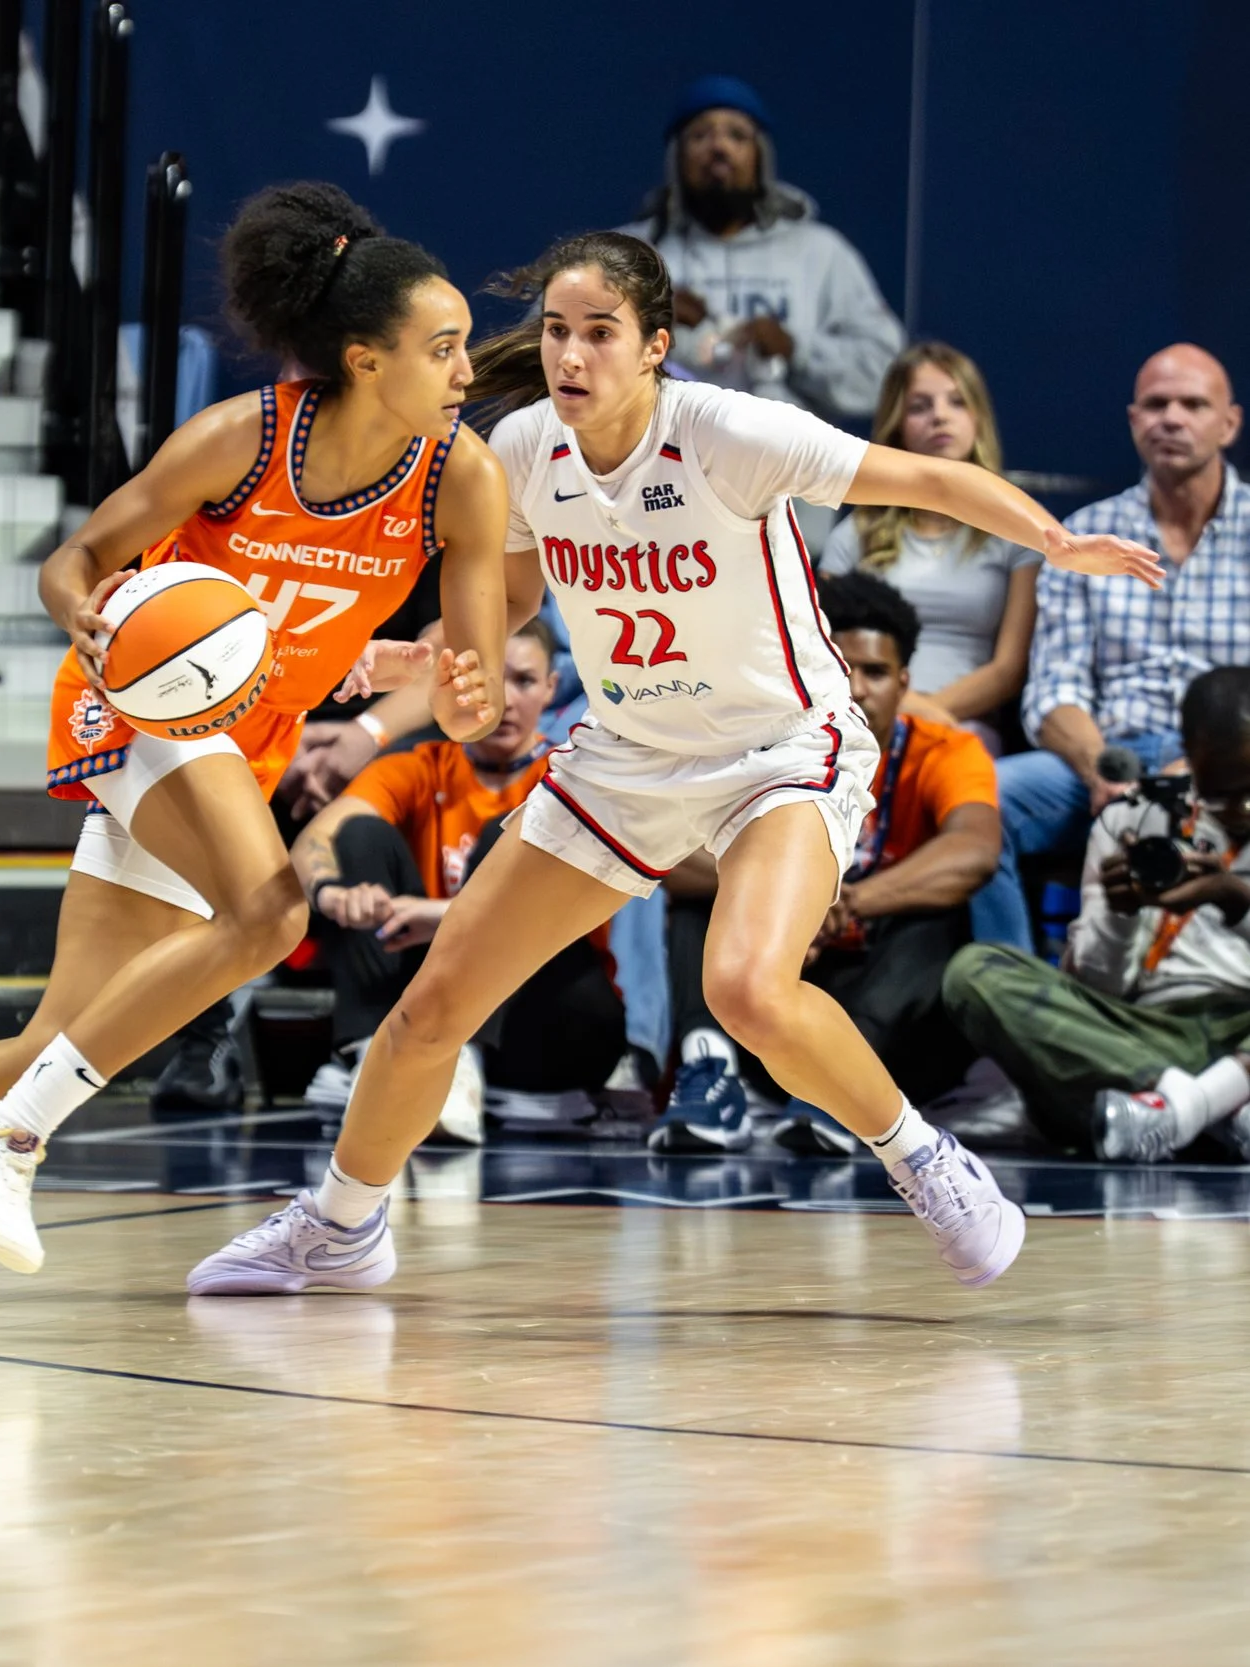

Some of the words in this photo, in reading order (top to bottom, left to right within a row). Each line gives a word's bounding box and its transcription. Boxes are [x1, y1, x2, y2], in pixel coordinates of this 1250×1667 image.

[641, 483, 675, 499] CAR
[643, 494, 686, 512] max
[228, 532, 406, 577] CONNECTICUT
[245, 573, 360, 634] 47
[595, 607, 688, 668] 22
[625, 680, 712, 700] VANDA
[84, 704, 103, 726] C
